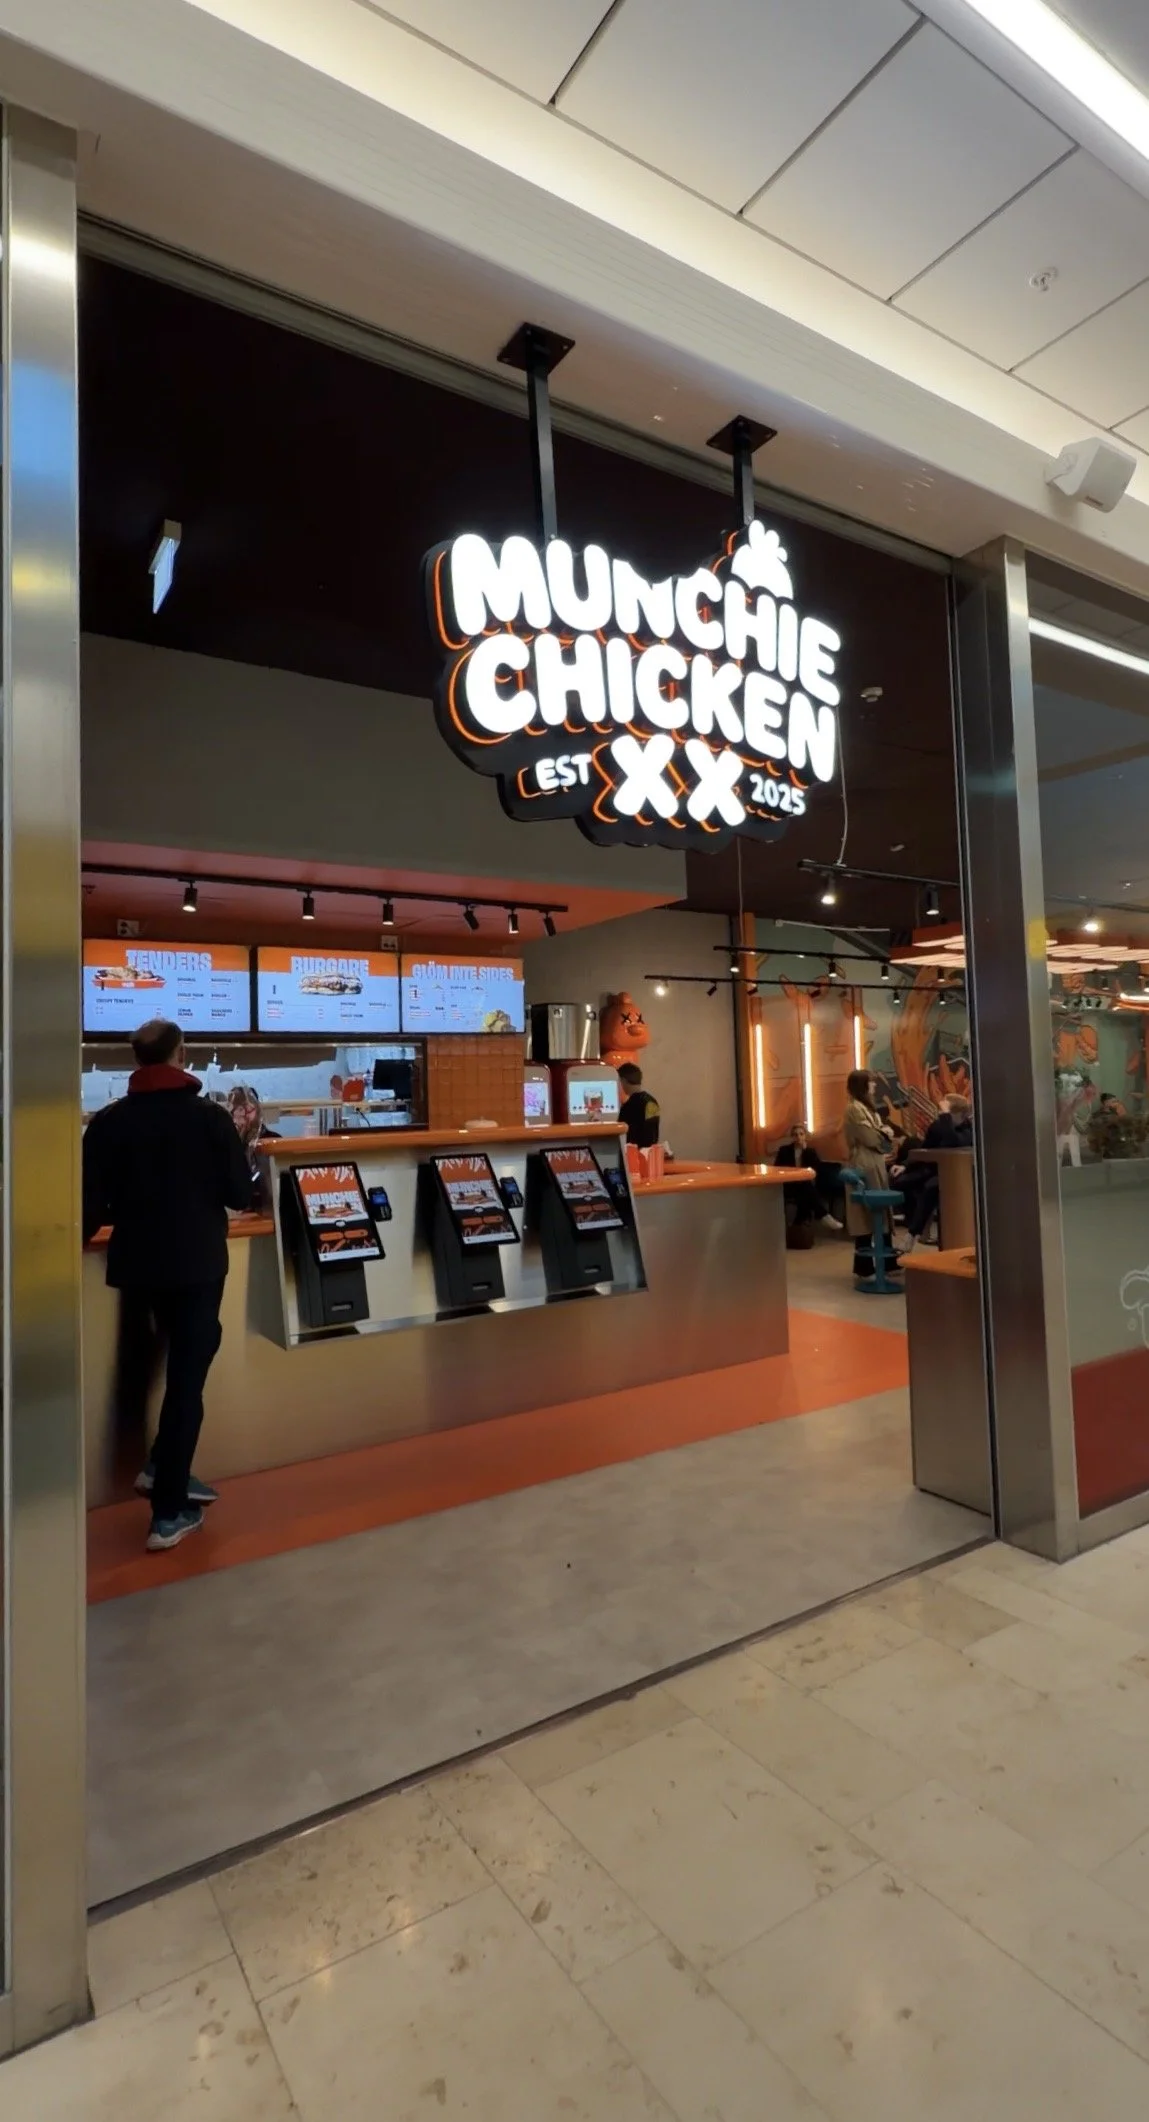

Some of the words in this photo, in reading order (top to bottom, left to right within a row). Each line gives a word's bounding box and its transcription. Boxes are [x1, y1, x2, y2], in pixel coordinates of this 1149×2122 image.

[450, 534, 841, 706] MUNCHIE
[465, 634, 838, 782] CHICKEN
[535, 752, 592, 790] EST
[749, 773, 807, 815] 2025
[126, 949, 212, 971] TENDERS
[412, 960, 448, 980] GLÖM
[450, 965, 477, 980] INTE
[478, 967, 514, 981] SIDES
